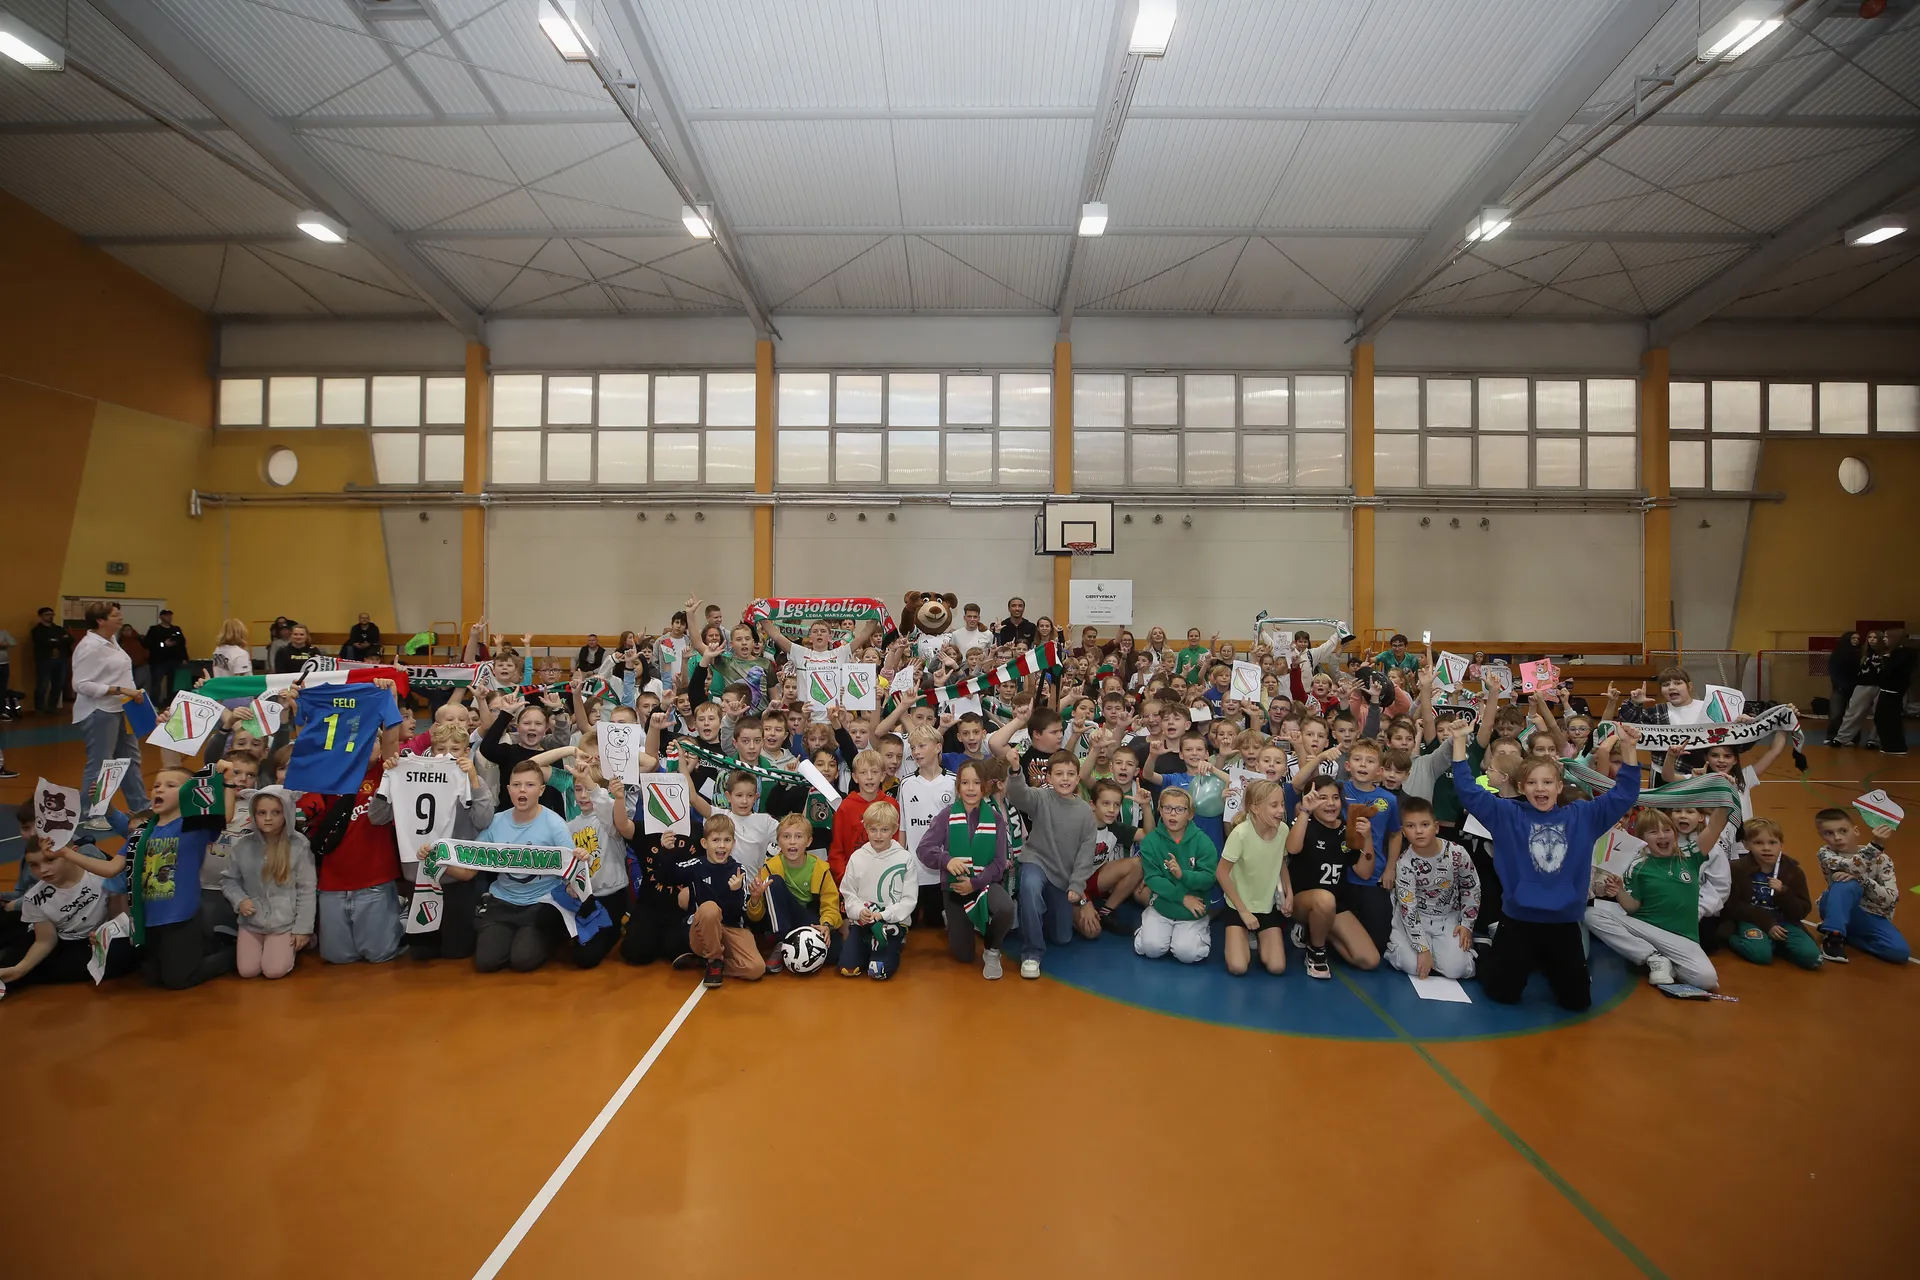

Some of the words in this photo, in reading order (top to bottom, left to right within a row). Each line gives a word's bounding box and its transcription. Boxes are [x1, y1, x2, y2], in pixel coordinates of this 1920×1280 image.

[775, 599, 871, 618] Legioholicy
[779, 624, 803, 635] EGIA
[406, 772, 448, 783] STREHL
[415, 793, 436, 836] 9
[455, 845, 562, 869] WARSZAWA
[1320, 862, 1343, 885] 25
